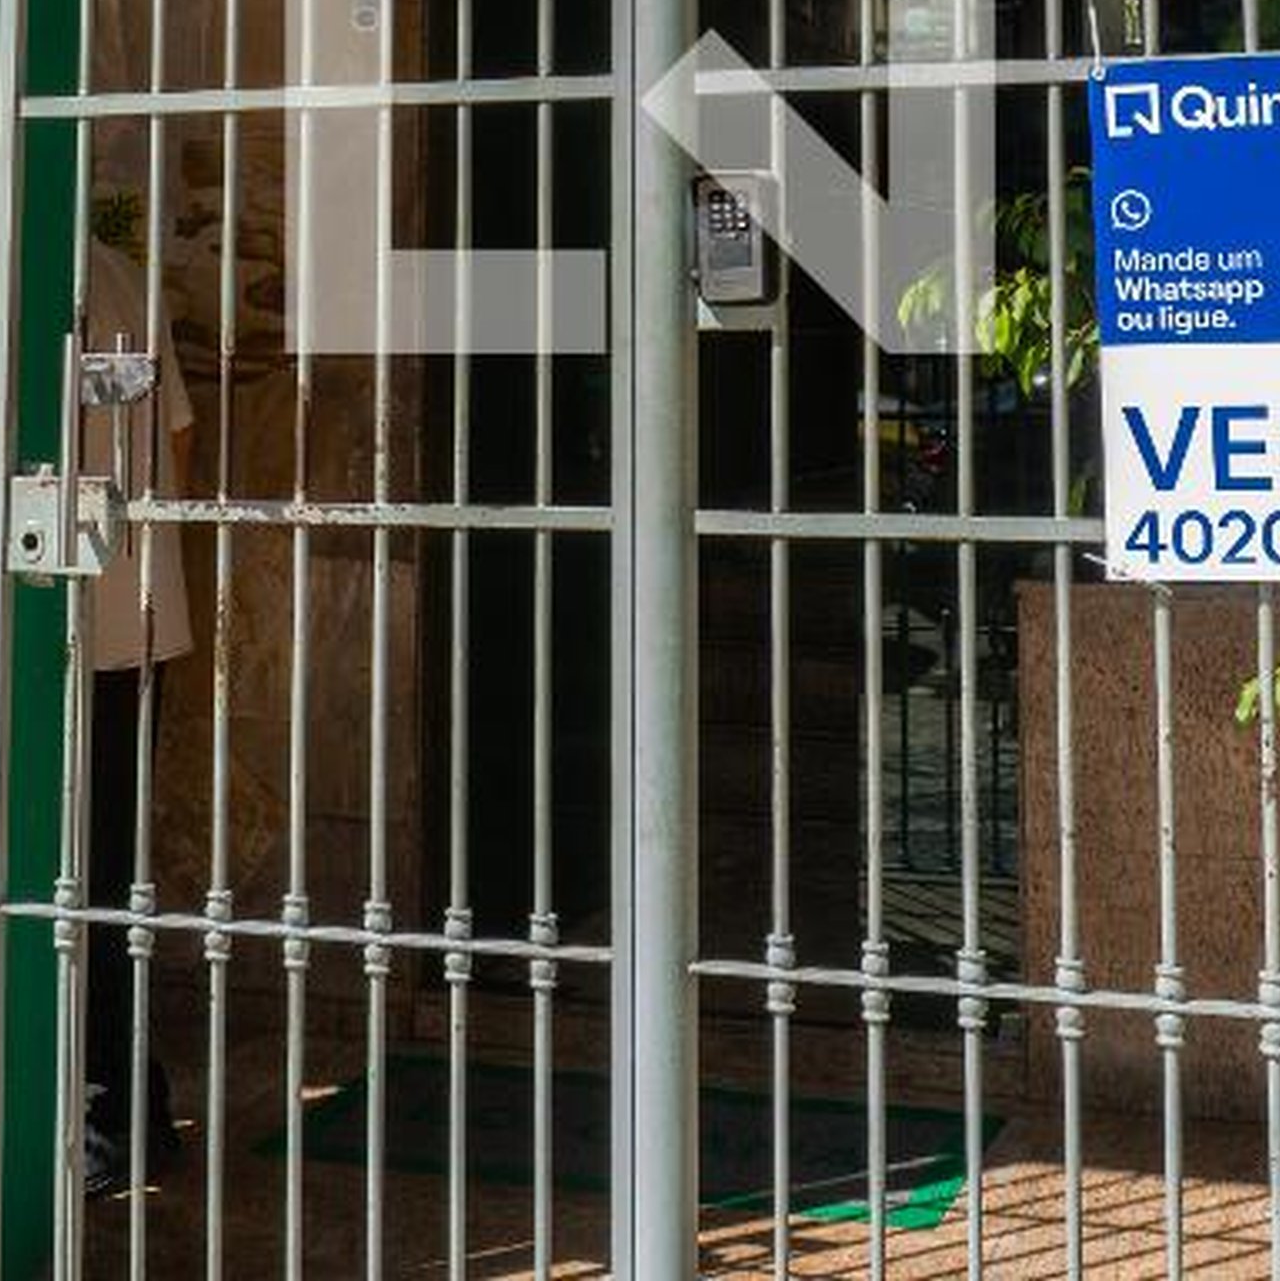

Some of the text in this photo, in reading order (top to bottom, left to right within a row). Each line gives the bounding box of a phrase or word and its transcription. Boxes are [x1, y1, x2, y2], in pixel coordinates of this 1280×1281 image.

[1114, 249, 1263, 274] Mande um
[1115, 278, 1265, 306] Whatsapp
[1117, 305, 1237, 335] ou ligue.
